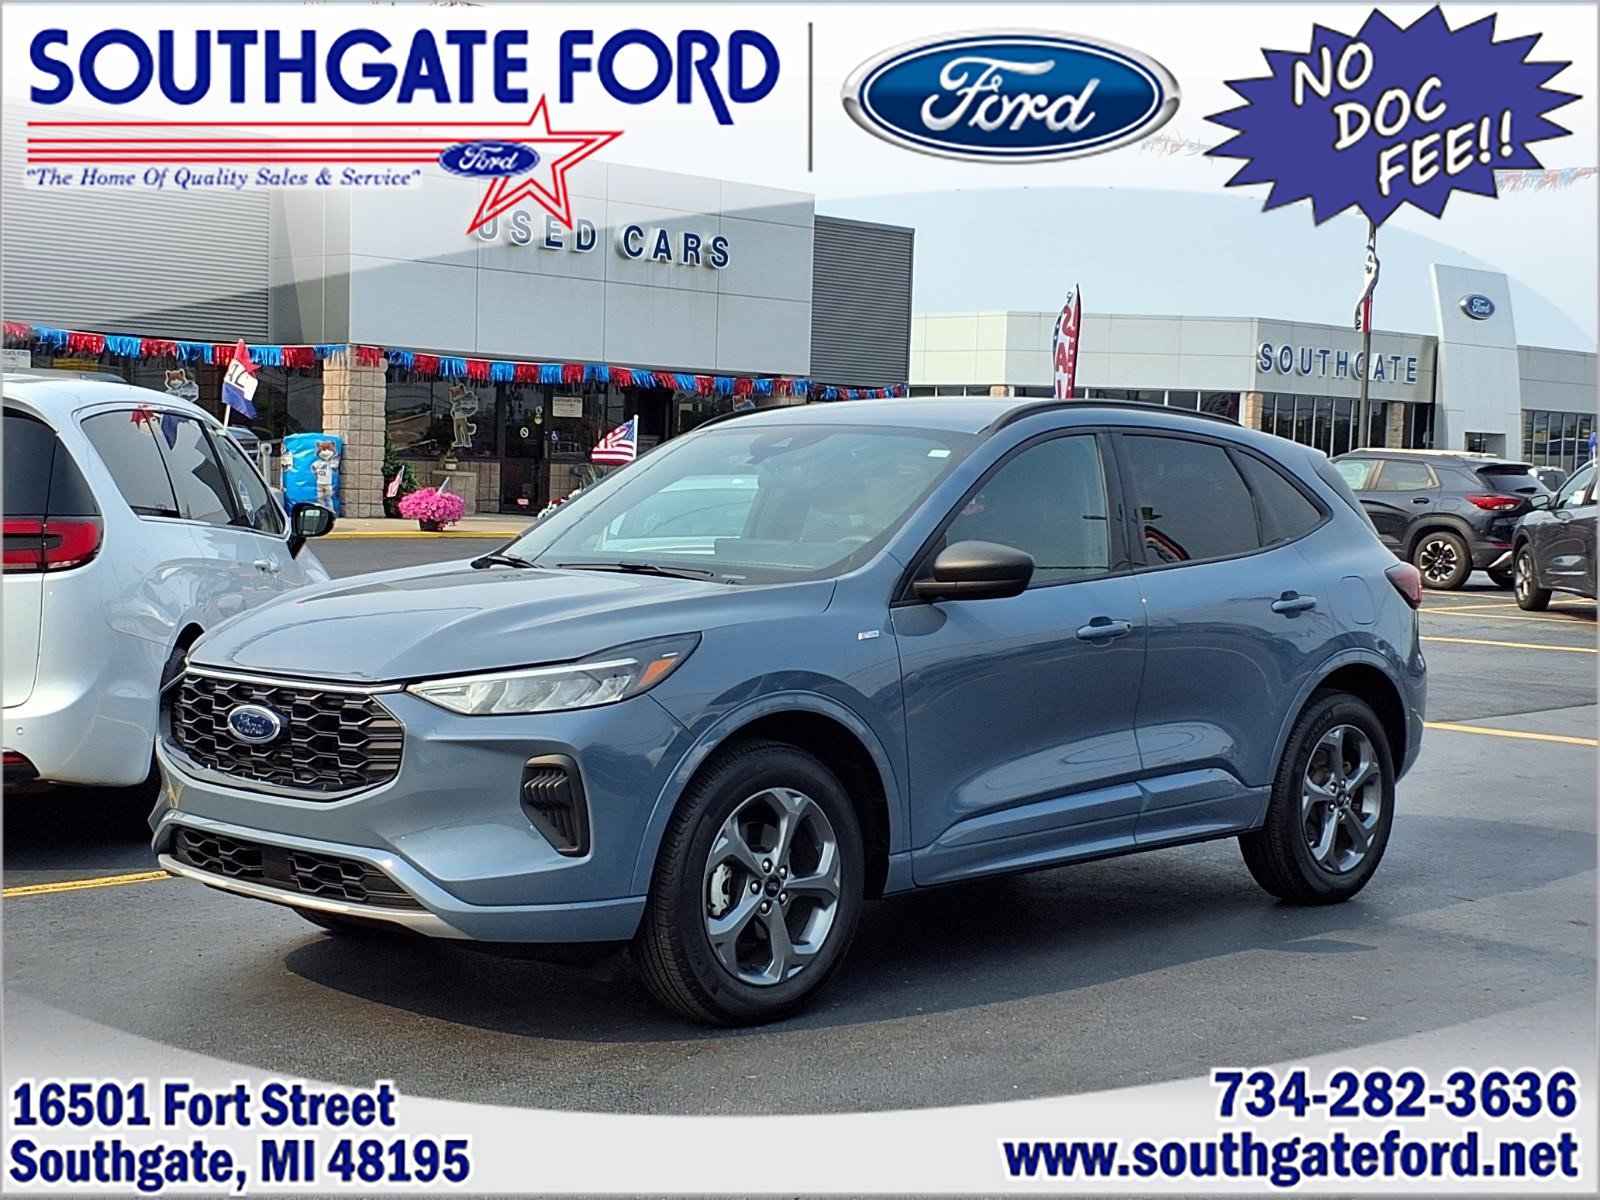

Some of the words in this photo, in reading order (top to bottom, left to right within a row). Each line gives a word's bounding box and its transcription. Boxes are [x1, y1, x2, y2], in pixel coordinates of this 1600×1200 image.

[476, 207, 597, 252] USED
[620, 223, 730, 269] CARS
[1256, 342, 1418, 384] SOUTHGATE
[236, 712, 265, 735] Ford
